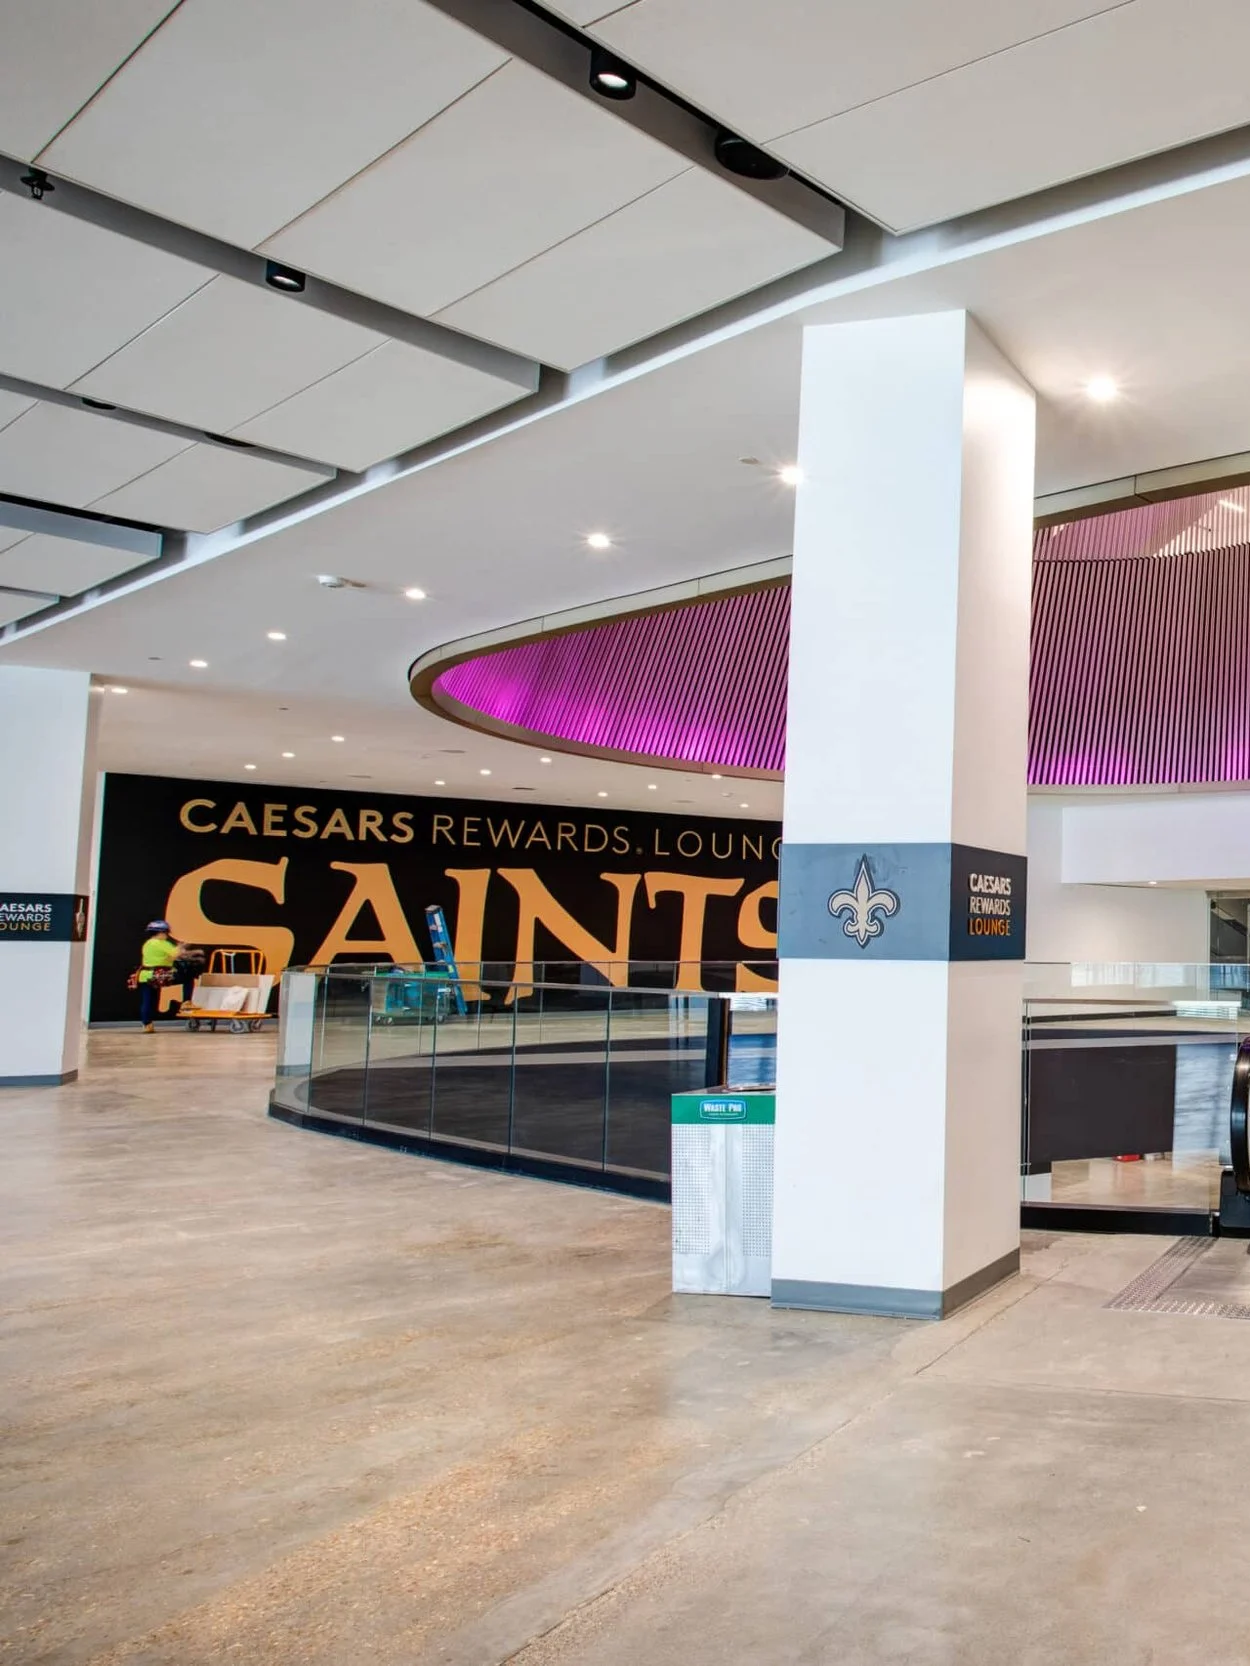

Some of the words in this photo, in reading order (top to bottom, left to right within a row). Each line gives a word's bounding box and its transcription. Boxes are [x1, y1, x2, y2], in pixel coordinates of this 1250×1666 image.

[179, 798, 415, 844] CAESARS
[969, 873, 1012, 896] CAESARS
[0, 903, 53, 913] AESARS
[969, 896, 1011, 916] REWARDS
[0, 913, 52, 922] EWARDS
[0, 922, 51, 931] OUNGE
[969, 917, 1012, 937] LOUNGE
